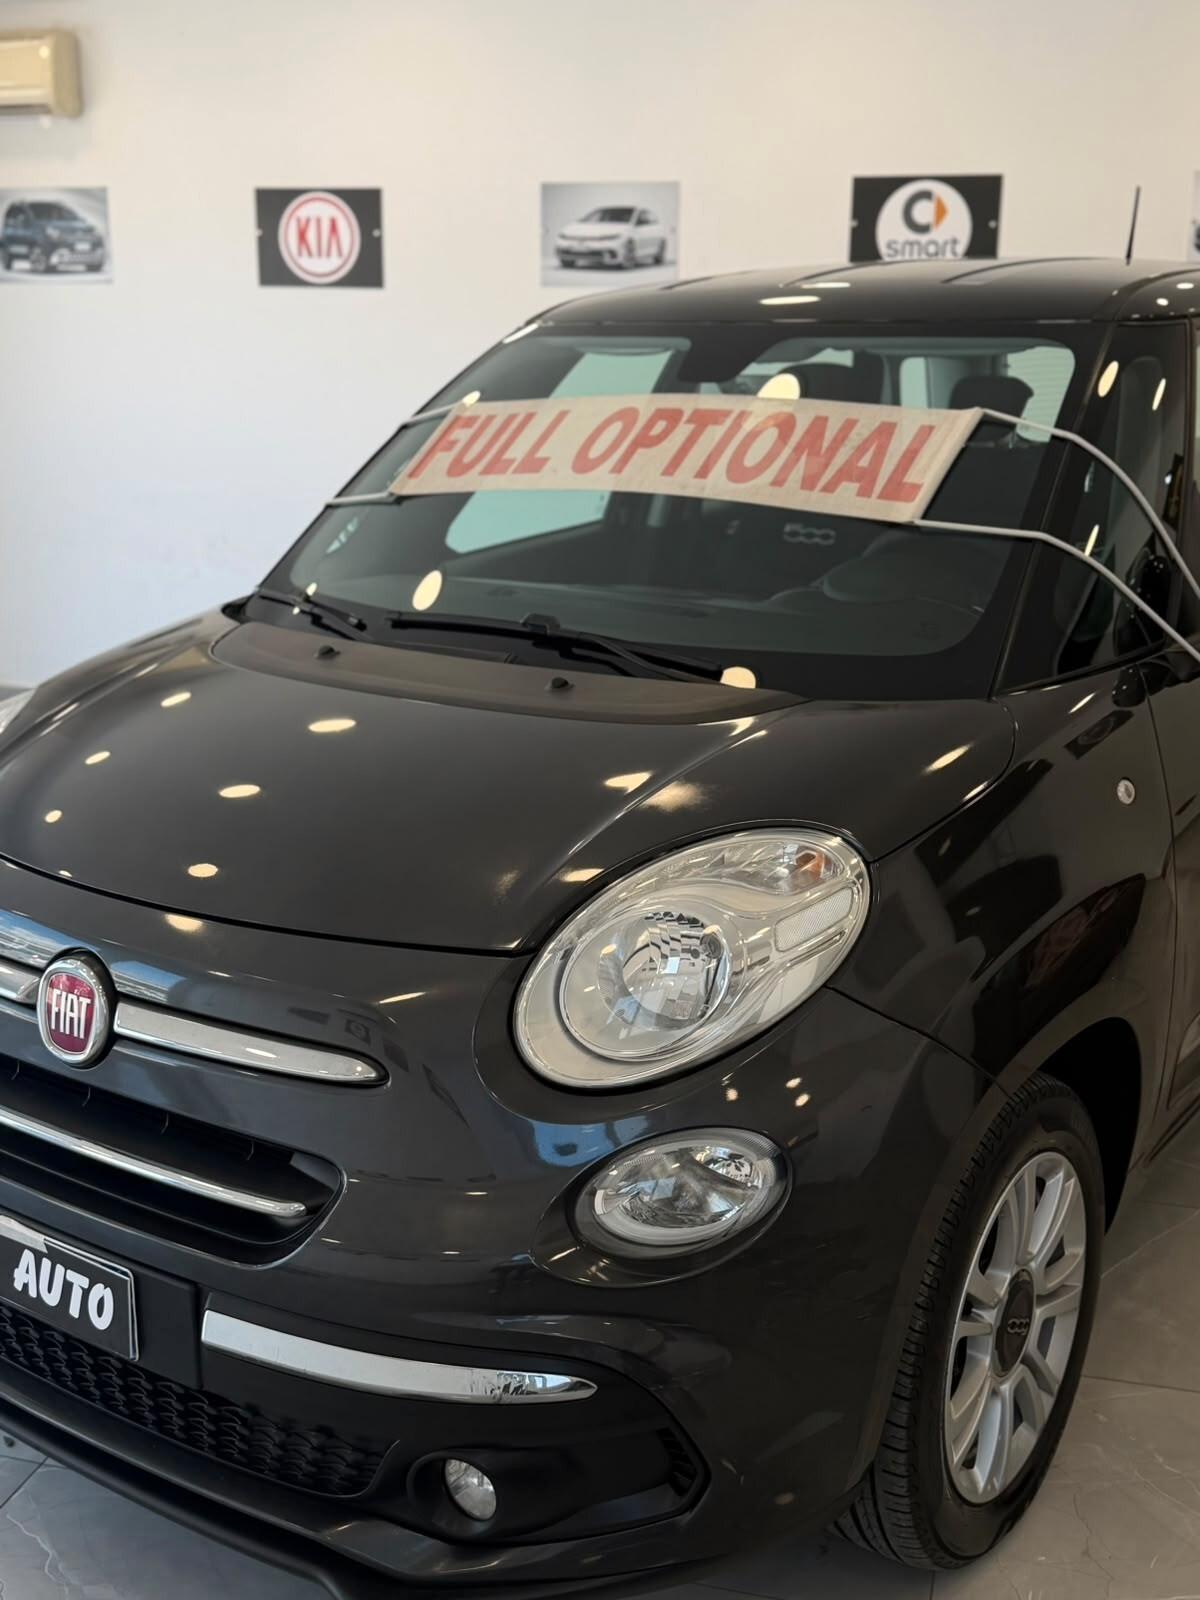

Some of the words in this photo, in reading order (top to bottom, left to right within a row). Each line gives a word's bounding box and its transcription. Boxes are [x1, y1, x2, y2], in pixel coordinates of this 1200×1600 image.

[295, 216, 344, 258] KIA
[885, 237, 960, 258] smart
[406, 409, 571, 480] FULL
[570, 405, 936, 504] OPTIONAL
[51, 988, 92, 1040] FIAT
[13, 1248, 114, 1330] AUTO
